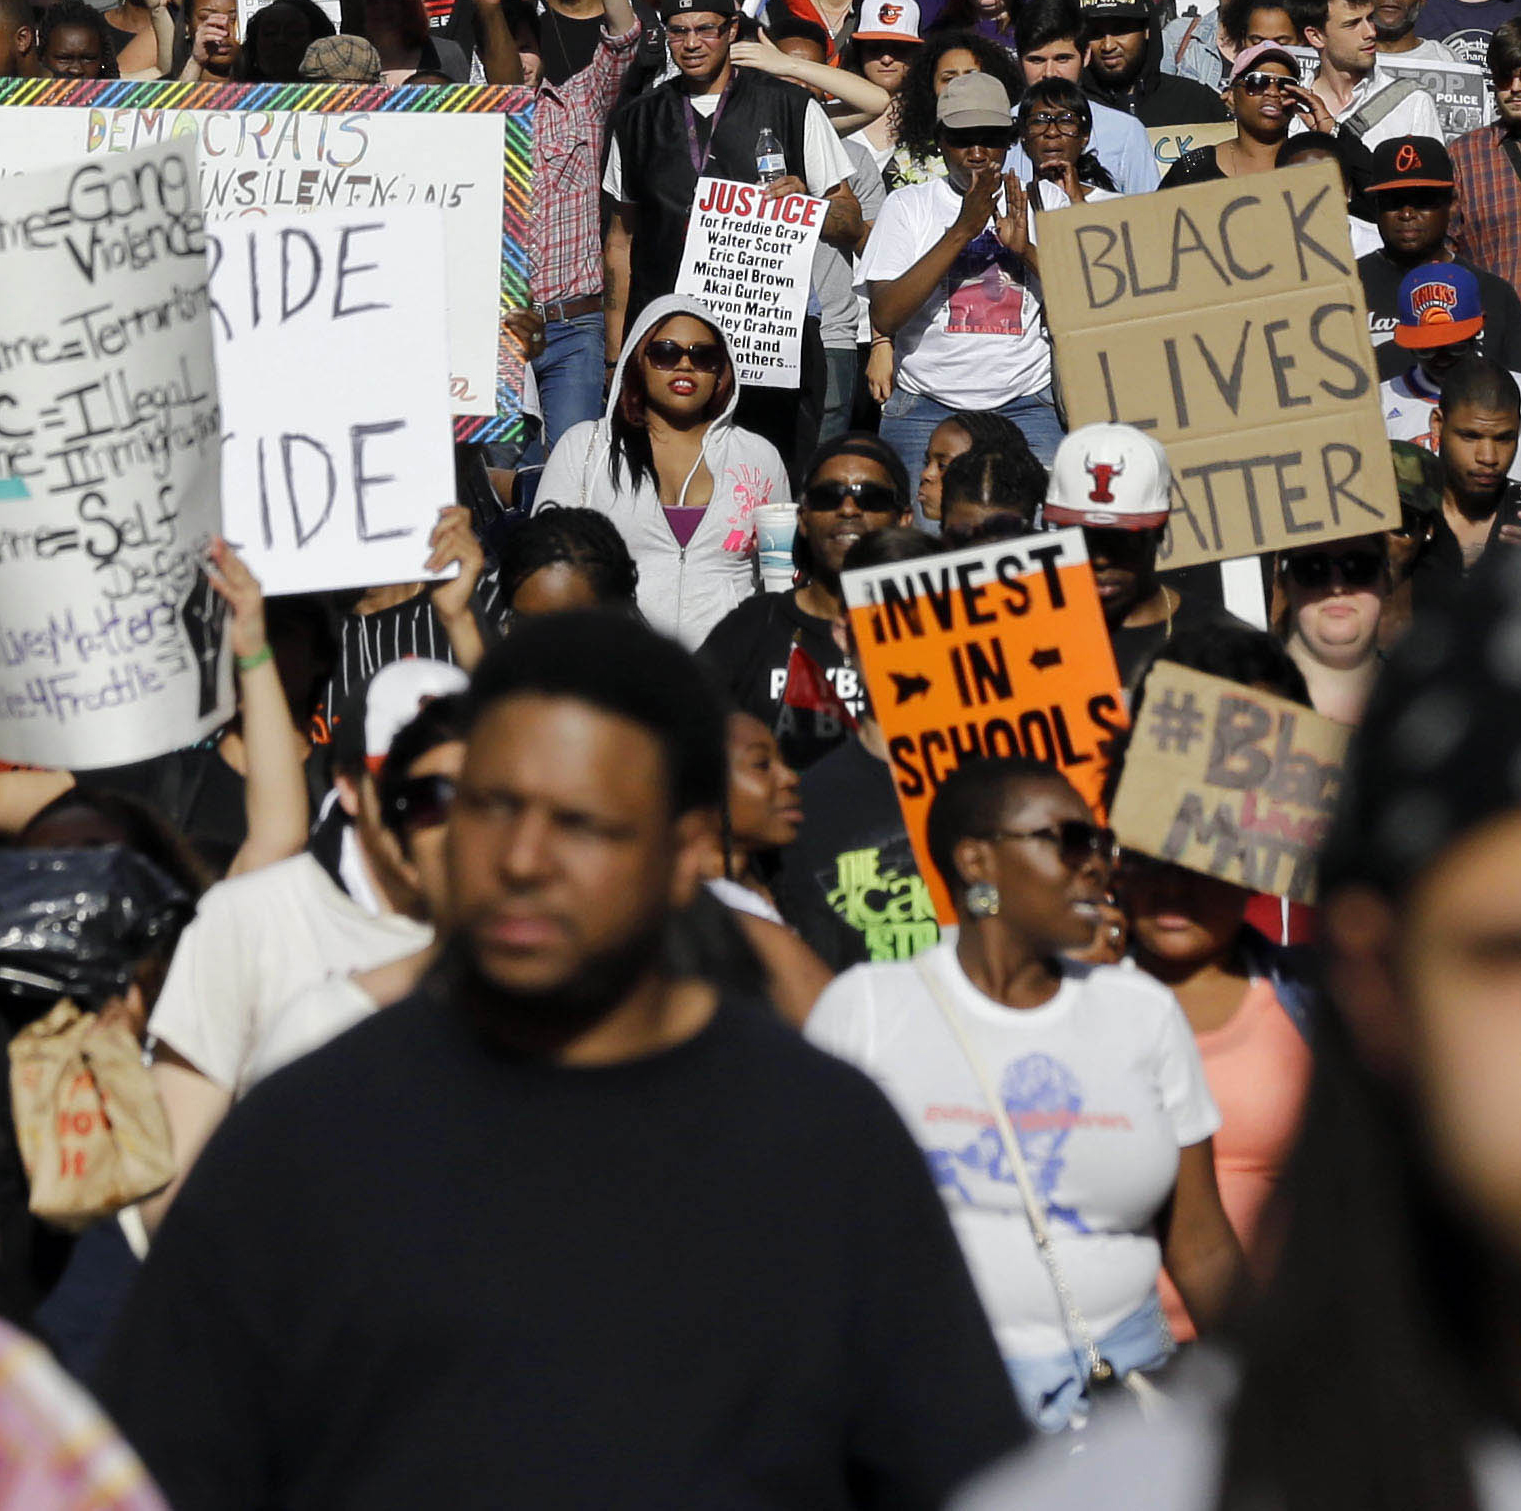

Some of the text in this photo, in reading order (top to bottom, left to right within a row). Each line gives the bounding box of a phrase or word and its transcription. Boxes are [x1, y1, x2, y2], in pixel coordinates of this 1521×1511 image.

[1435, 92, 1479, 106] POLICE
[698, 181, 822, 228] JUSTICE
[699, 214, 809, 244] for Freddie Gray
[707, 231, 793, 255] Walter Scott
[64, 210, 209, 285] Violence
[708, 247, 784, 271] Eric Garner
[1074, 184, 1353, 310] BLACK
[692, 261, 795, 289] Michael Brown
[702, 279, 781, 305] Akai Gurley
[744, 301, 793, 321] Martin
[743, 317, 798, 339] Graham
[754, 335, 781, 354] and
[1095, 302, 1372, 430] LIVES
[1160, 442, 1386, 560] ATTER
[78, 485, 179, 560] Self
[864, 545, 1067, 644] INVEST
[948, 636, 1014, 709] IN
